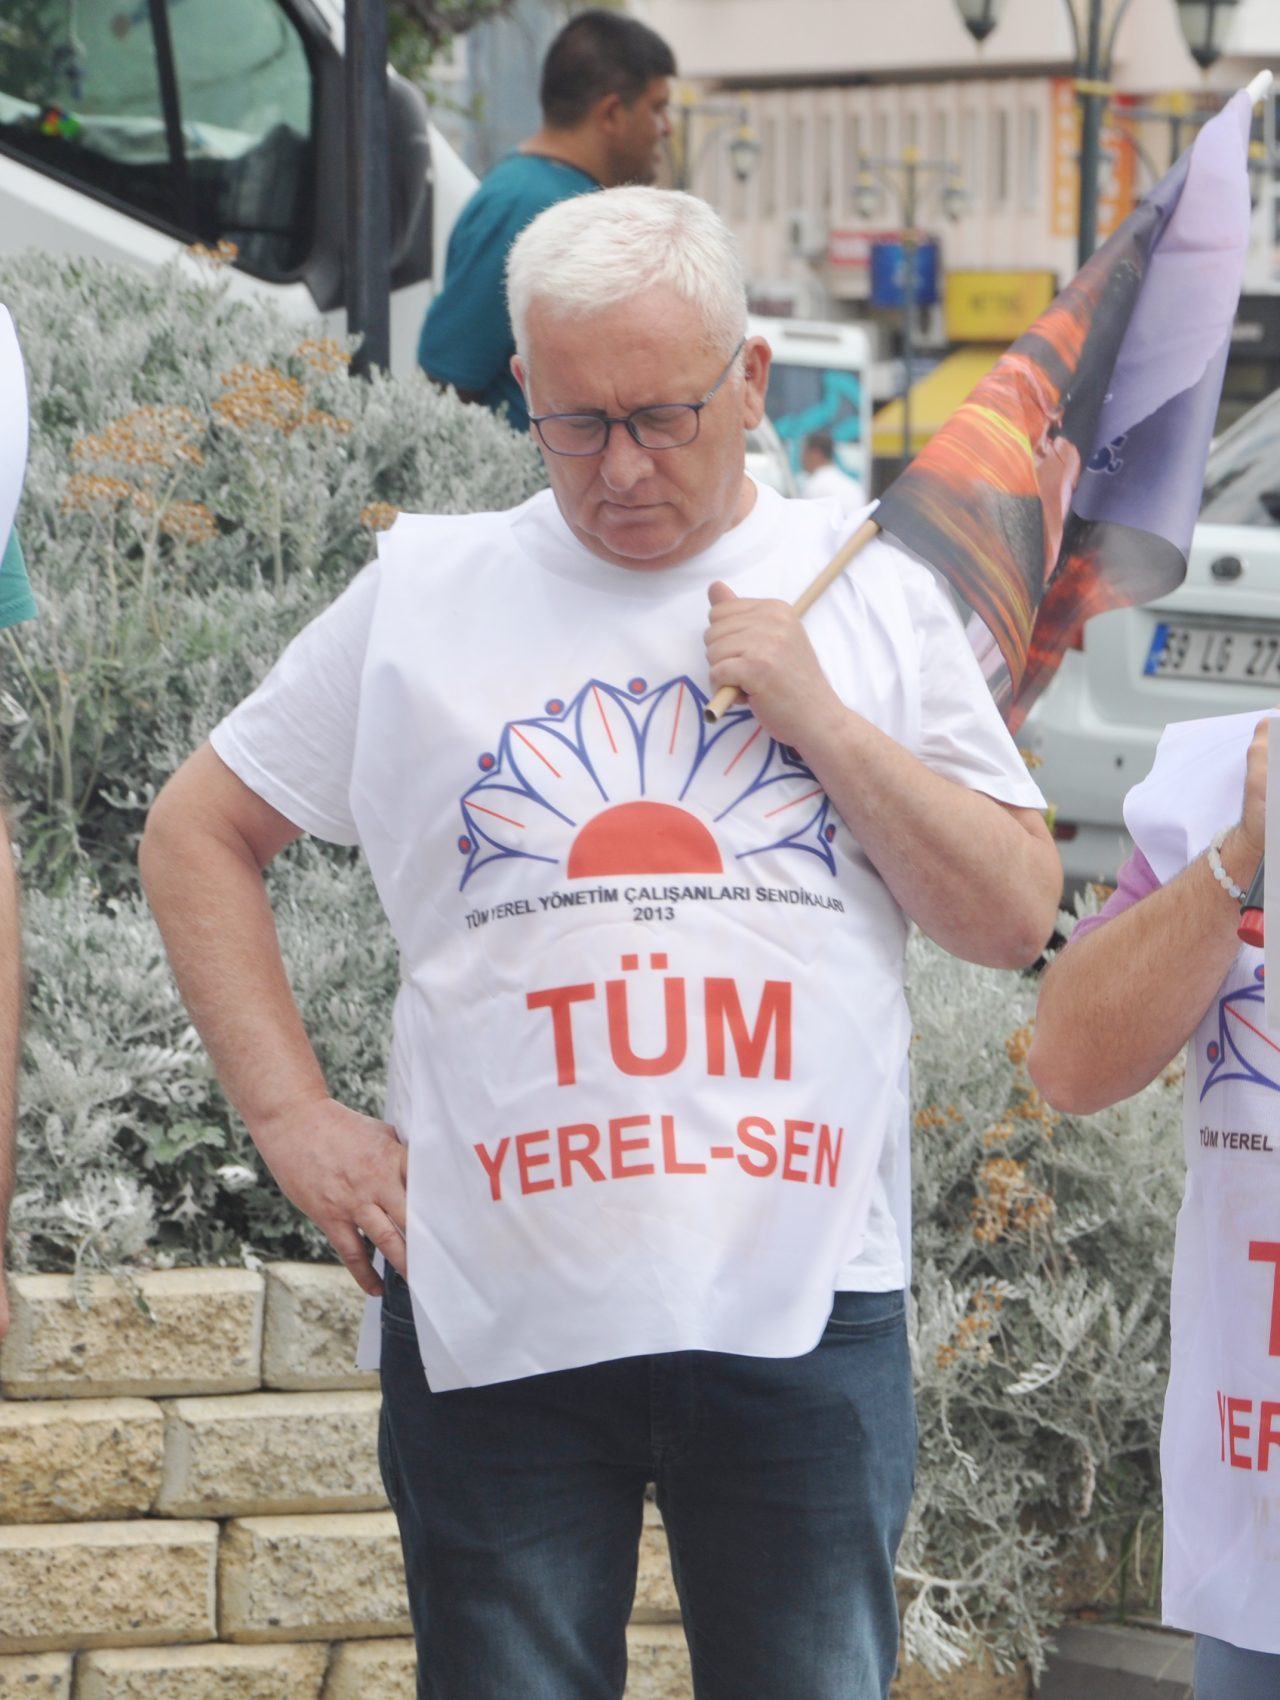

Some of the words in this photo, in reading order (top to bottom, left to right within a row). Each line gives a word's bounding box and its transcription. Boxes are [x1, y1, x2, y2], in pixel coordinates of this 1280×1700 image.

[538, 886, 618, 911] YÖNETİM
[624, 886, 751, 905] ÇALIŞANLARI
[755, 886, 845, 914] SENDİKALARI
[632, 906, 676, 922] 2013
[526, 953, 792, 1087] TÜM
[1200, 1126, 1219, 1149] TÜM
[1221, 1132, 1274, 1152] YEREL
[473, 1115, 843, 1201] YEREL-SEN
